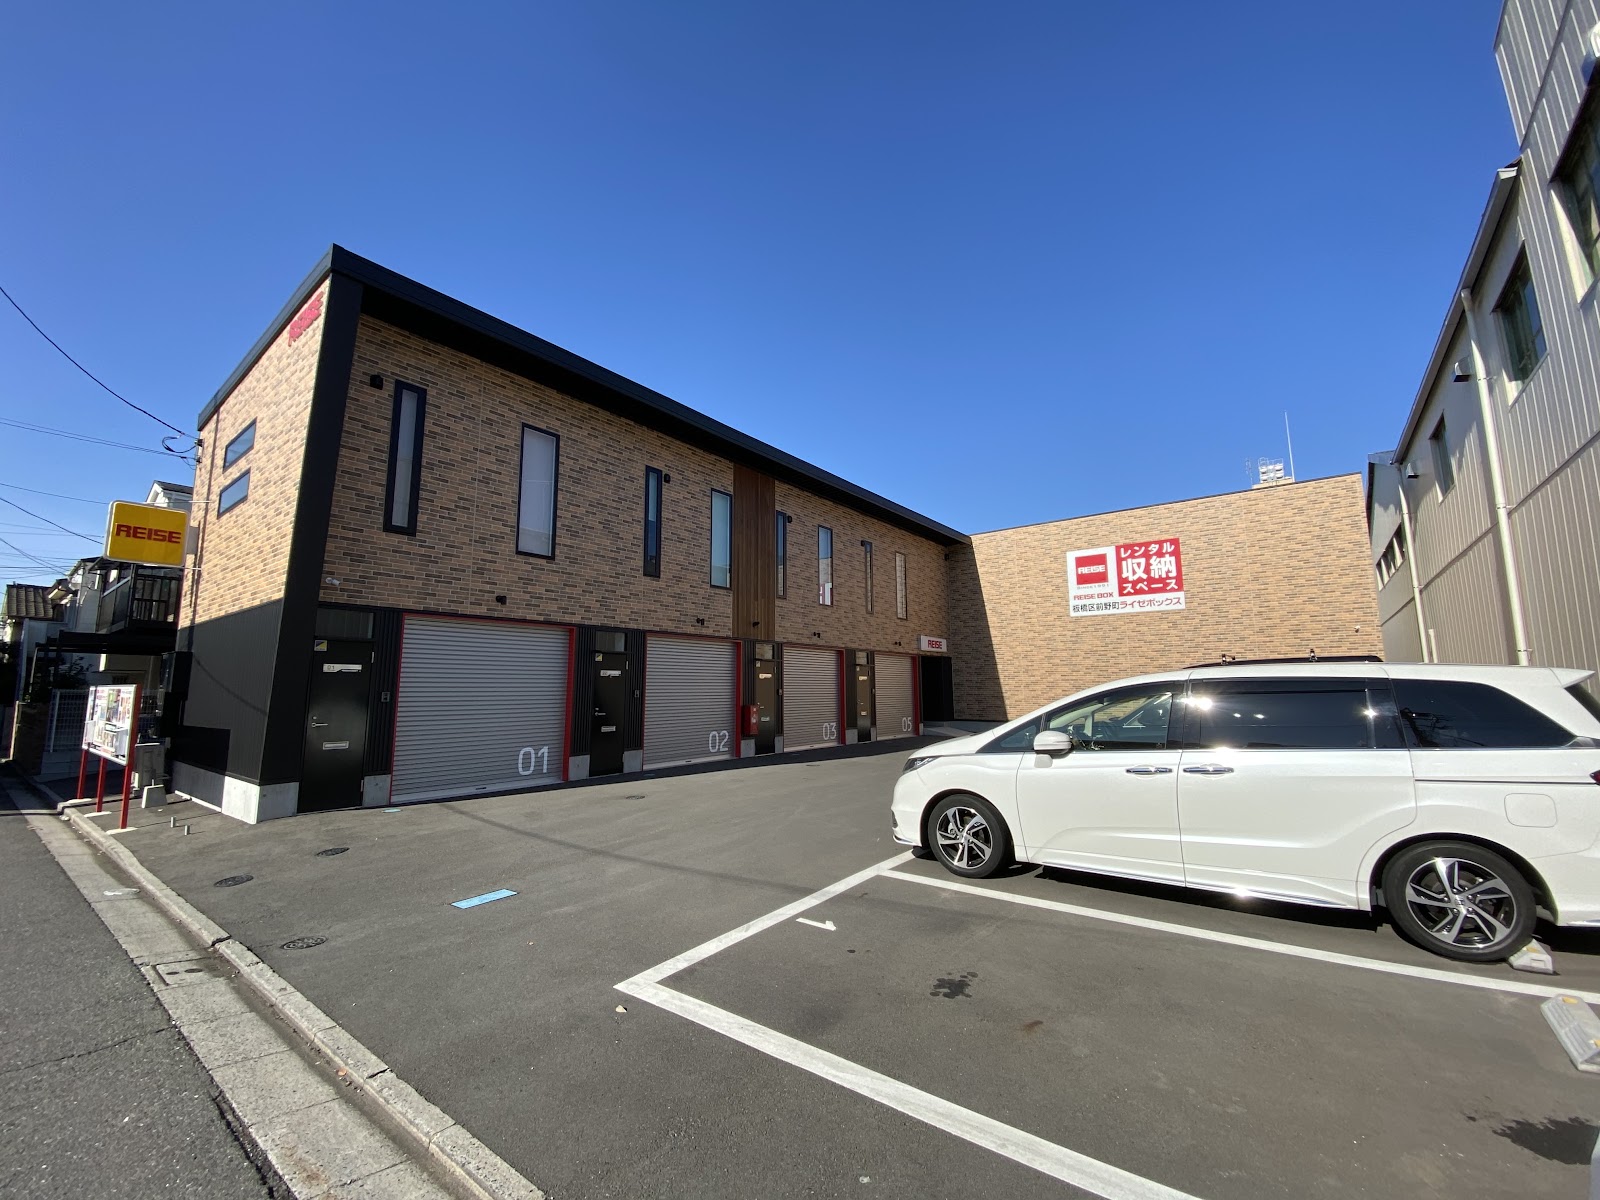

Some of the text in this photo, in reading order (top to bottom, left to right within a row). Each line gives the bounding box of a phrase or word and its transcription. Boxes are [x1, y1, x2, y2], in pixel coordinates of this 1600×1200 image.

[115, 523, 182, 544] REISE
[1120, 542, 1175, 558] レンタル
[1078, 565, 1105, 574] REISE
[1121, 554, 1177, 581] 収納
[1122, 579, 1179, 594] スペース
[928, 640, 942, 649] REISE
[823, 723, 837, 740] 03
[902, 717, 912, 732] 05
[708, 730, 729, 753] 02
[518, 746, 549, 776] 01
